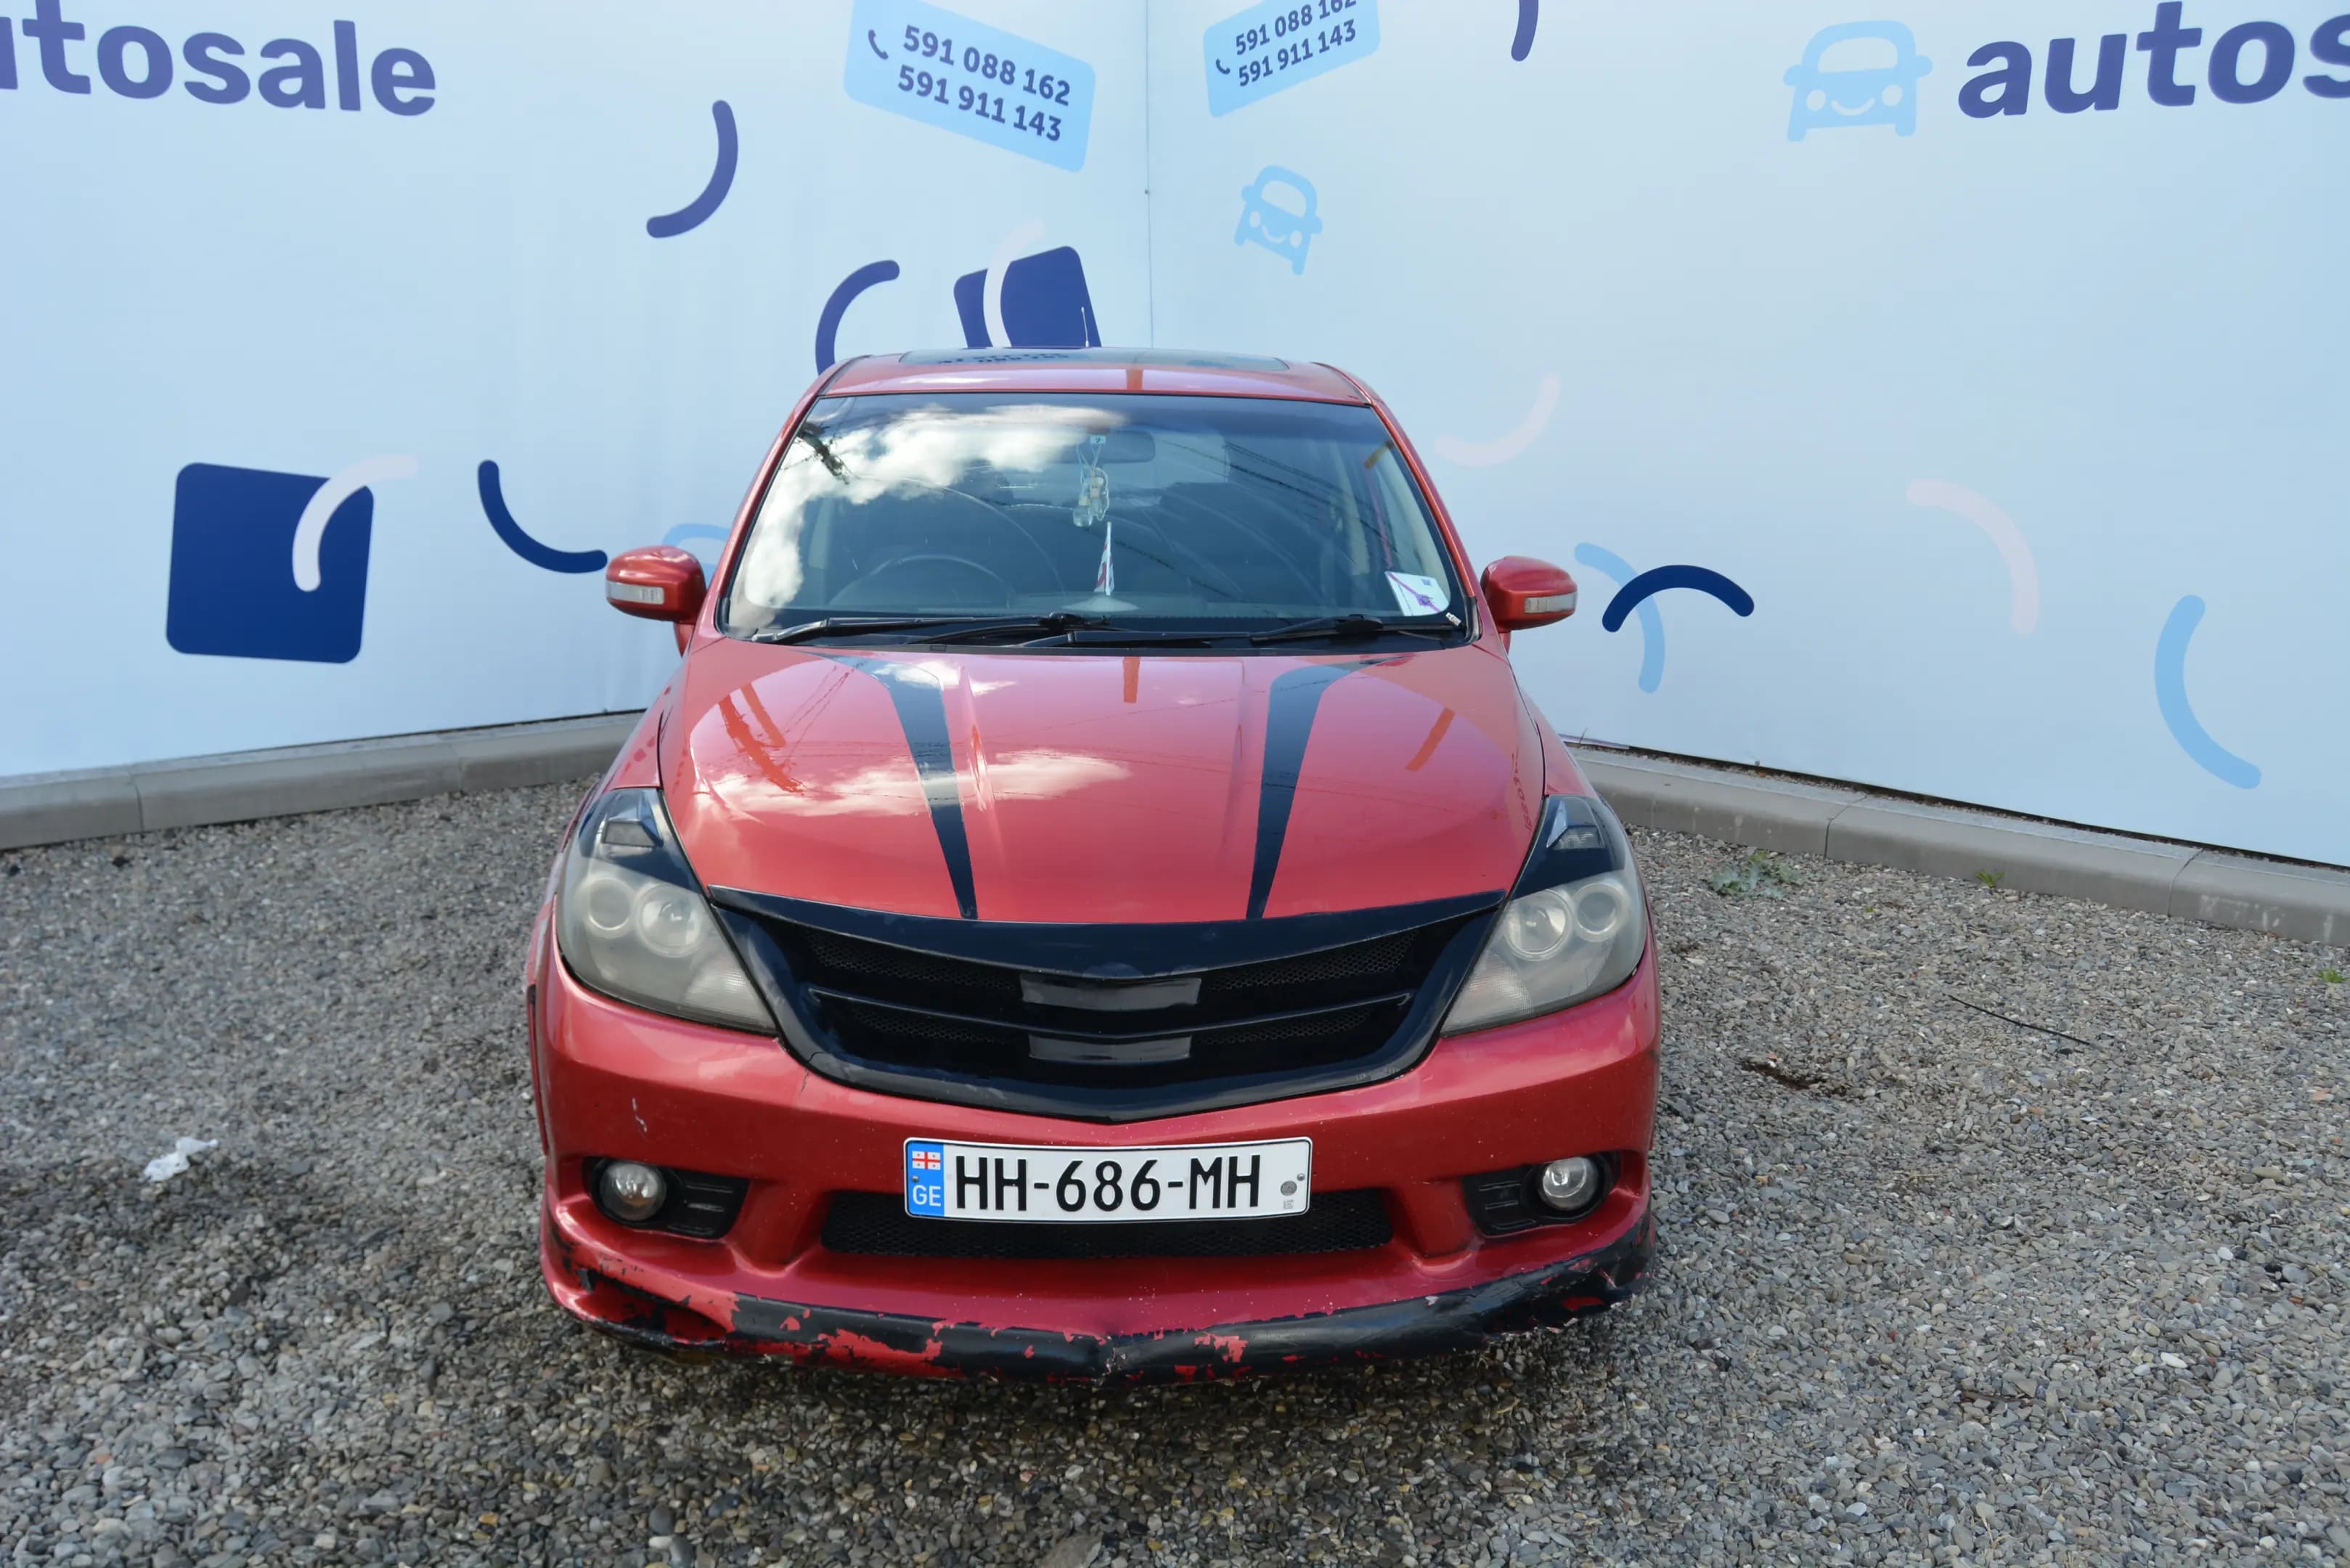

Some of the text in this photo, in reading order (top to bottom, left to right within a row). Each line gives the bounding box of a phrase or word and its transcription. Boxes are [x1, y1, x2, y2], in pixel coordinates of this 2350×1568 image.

[0, 0, 435, 116] tosale
[1236, 23, 1270, 55] 591
[1274, 4, 1313, 37] 088
[1239, 18, 1355, 86] 591 911 143
[903, 25, 1070, 107] 591 088 162
[898, 64, 1061, 141] 591 911 143
[912, 1185, 942, 1206] GE
[955, 1154, 1261, 1212] HH-686-MH
